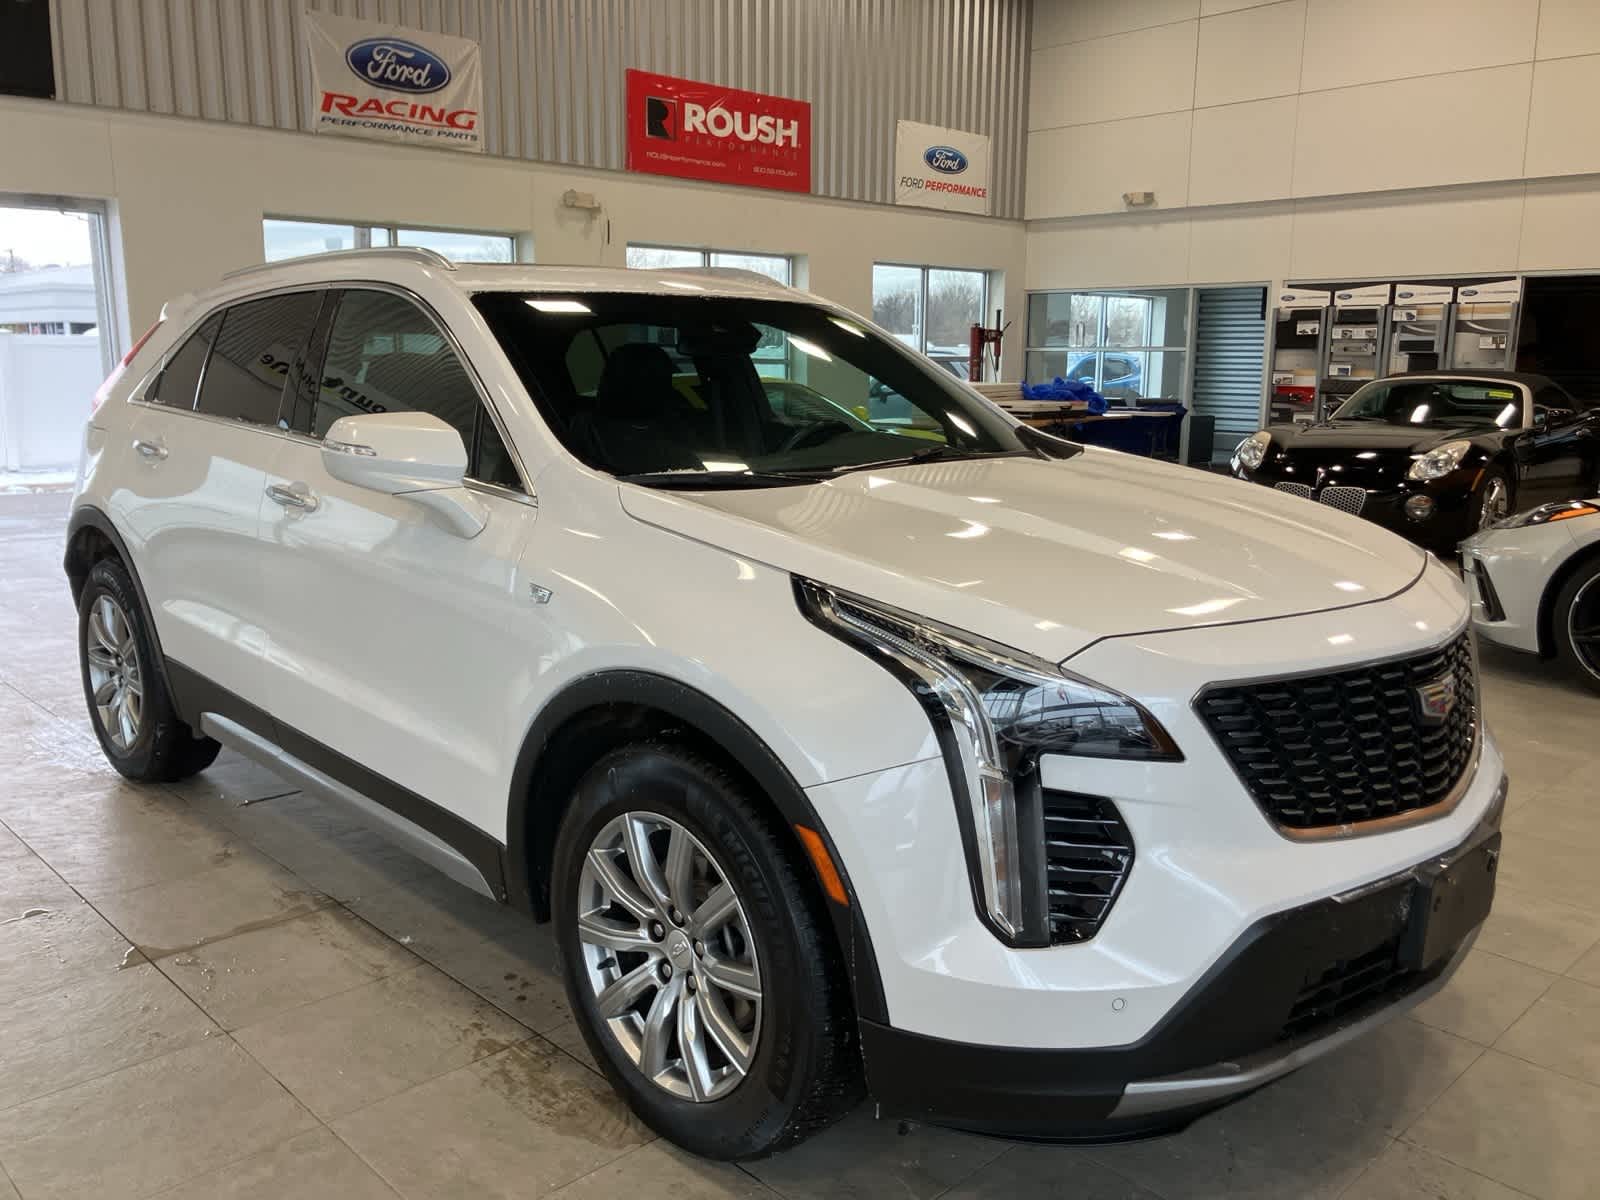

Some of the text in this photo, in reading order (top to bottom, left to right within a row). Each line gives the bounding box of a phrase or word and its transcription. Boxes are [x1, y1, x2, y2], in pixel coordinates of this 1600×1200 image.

[367, 45, 431, 87] Ford
[320, 91, 478, 130] RACING
[684, 103, 799, 148] ROUSH
[320, 116, 478, 142] PERFORMANCE PARTS
[932, 149, 960, 170] Ford
[900, 177, 987, 198] FORD PERFORMANCE
